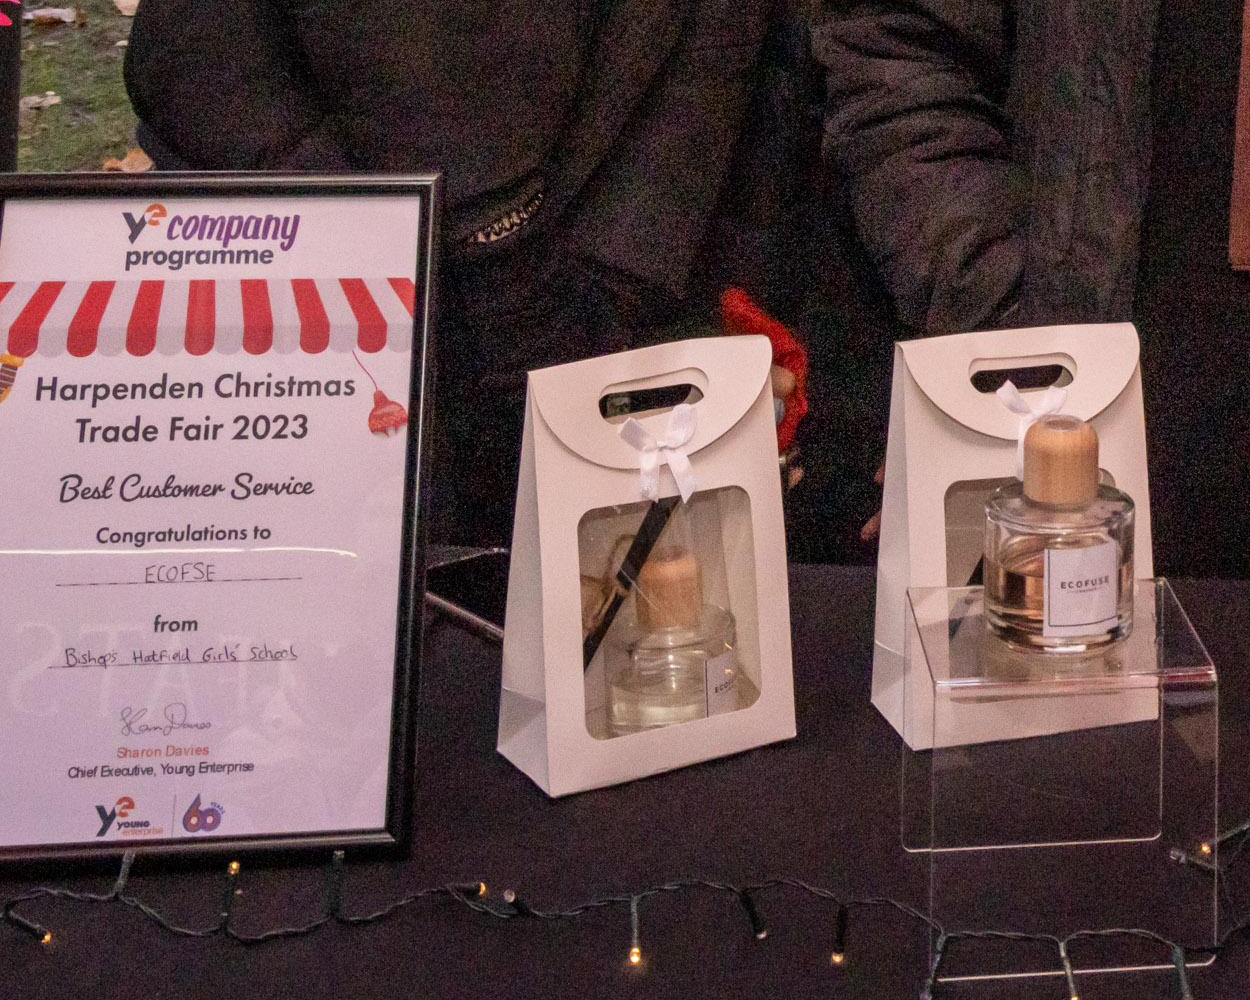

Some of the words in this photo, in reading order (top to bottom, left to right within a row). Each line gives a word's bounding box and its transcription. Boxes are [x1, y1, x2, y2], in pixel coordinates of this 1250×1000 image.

[166, 214, 300, 251] company
[125, 249, 274, 272] programme
[35, 373, 204, 408] Harpenden
[214, 371, 356, 398] Christmas
[76, 415, 159, 443] Trade
[169, 416, 224, 441] Fair
[232, 414, 309, 440] 2023
[59, 473, 116, 502] Best
[119, 473, 226, 502] Customer
[230, 472, 315, 500] Service
[96, 524, 248, 547] Congratulations
[253, 525, 272, 540] to
[145, 562, 216, 584] ECOFSE
[1060, 575, 1110, 590] ECOFUSE
[154, 614, 198, 633] from
[249, 644, 299, 661] School
[116, 746, 162, 759] Sharon
[165, 745, 210, 758] Davies
[68, 765, 98, 779] Chief
[100, 764, 157, 778] Executive,
[160, 762, 195, 777] Young
[198, 761, 255, 776] Enterprise
[182, 793, 222, 833] 60
[122, 826, 164, 837] enterprise
